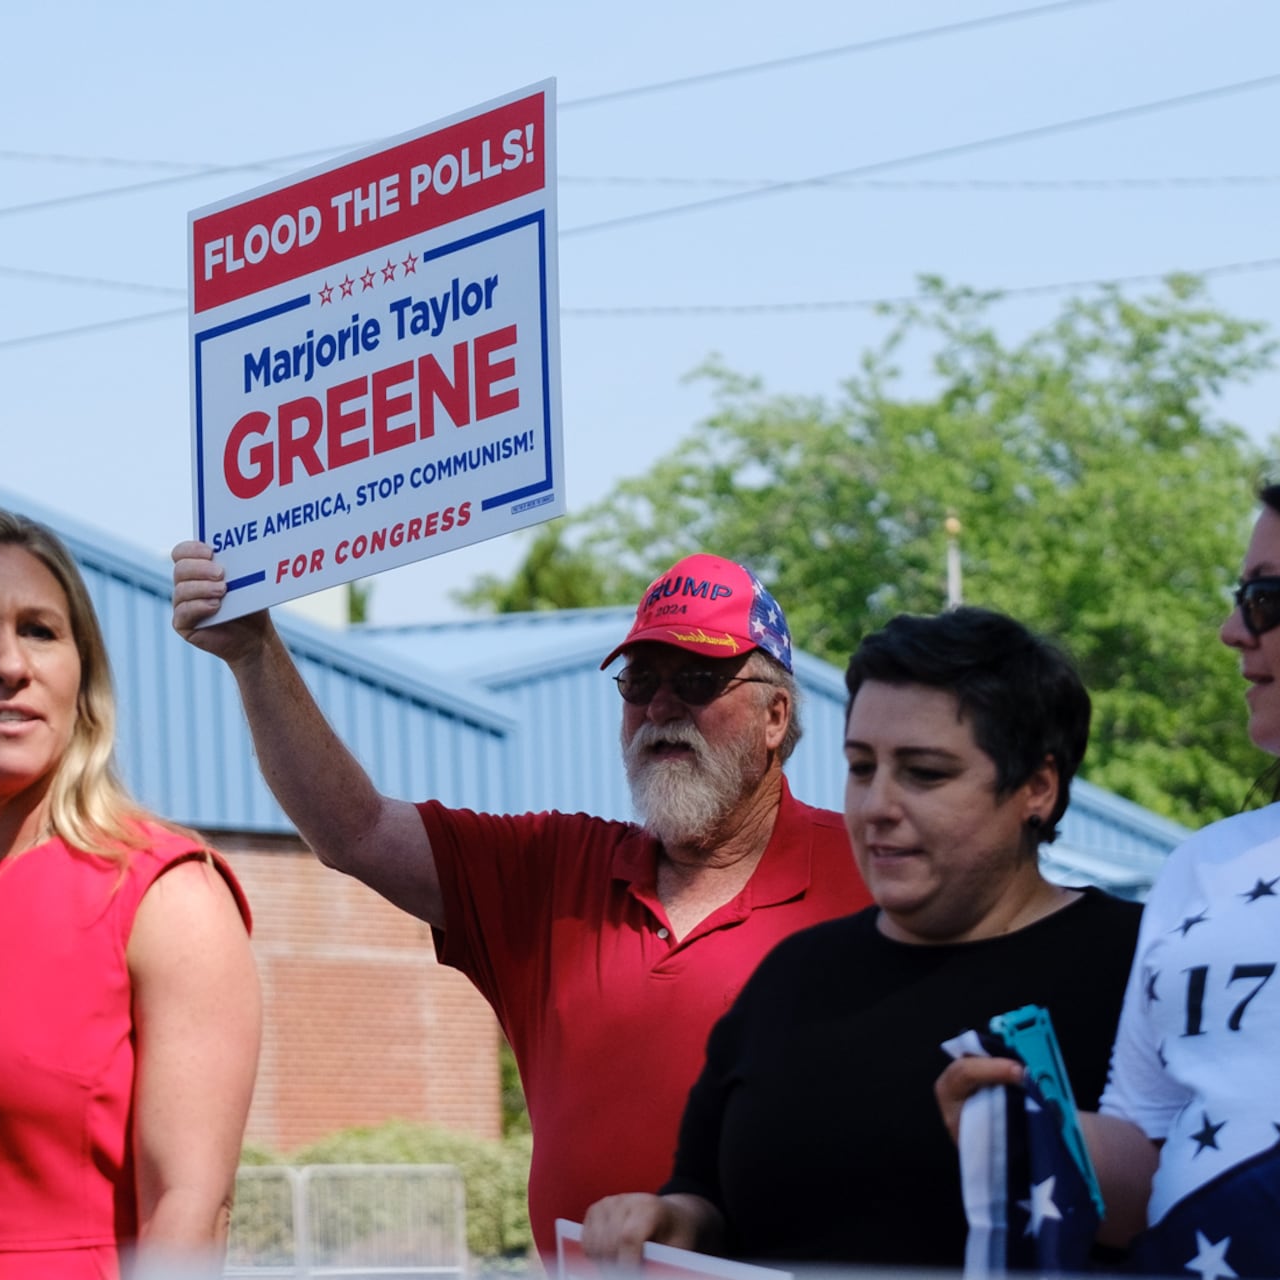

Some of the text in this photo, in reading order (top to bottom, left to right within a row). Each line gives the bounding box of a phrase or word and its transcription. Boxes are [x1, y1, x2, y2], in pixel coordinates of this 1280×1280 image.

[204, 123, 535, 281] FLOOD THE POLLS!
[244, 274, 499, 394] Marjorie Taylor
[223, 323, 520, 500] GREENE
[212, 430, 535, 554] SAVE AMERICA, STOP COMMUNISM!
[275, 501, 472, 584] FOR CONGRESS
[656, 603, 688, 617] 2024
